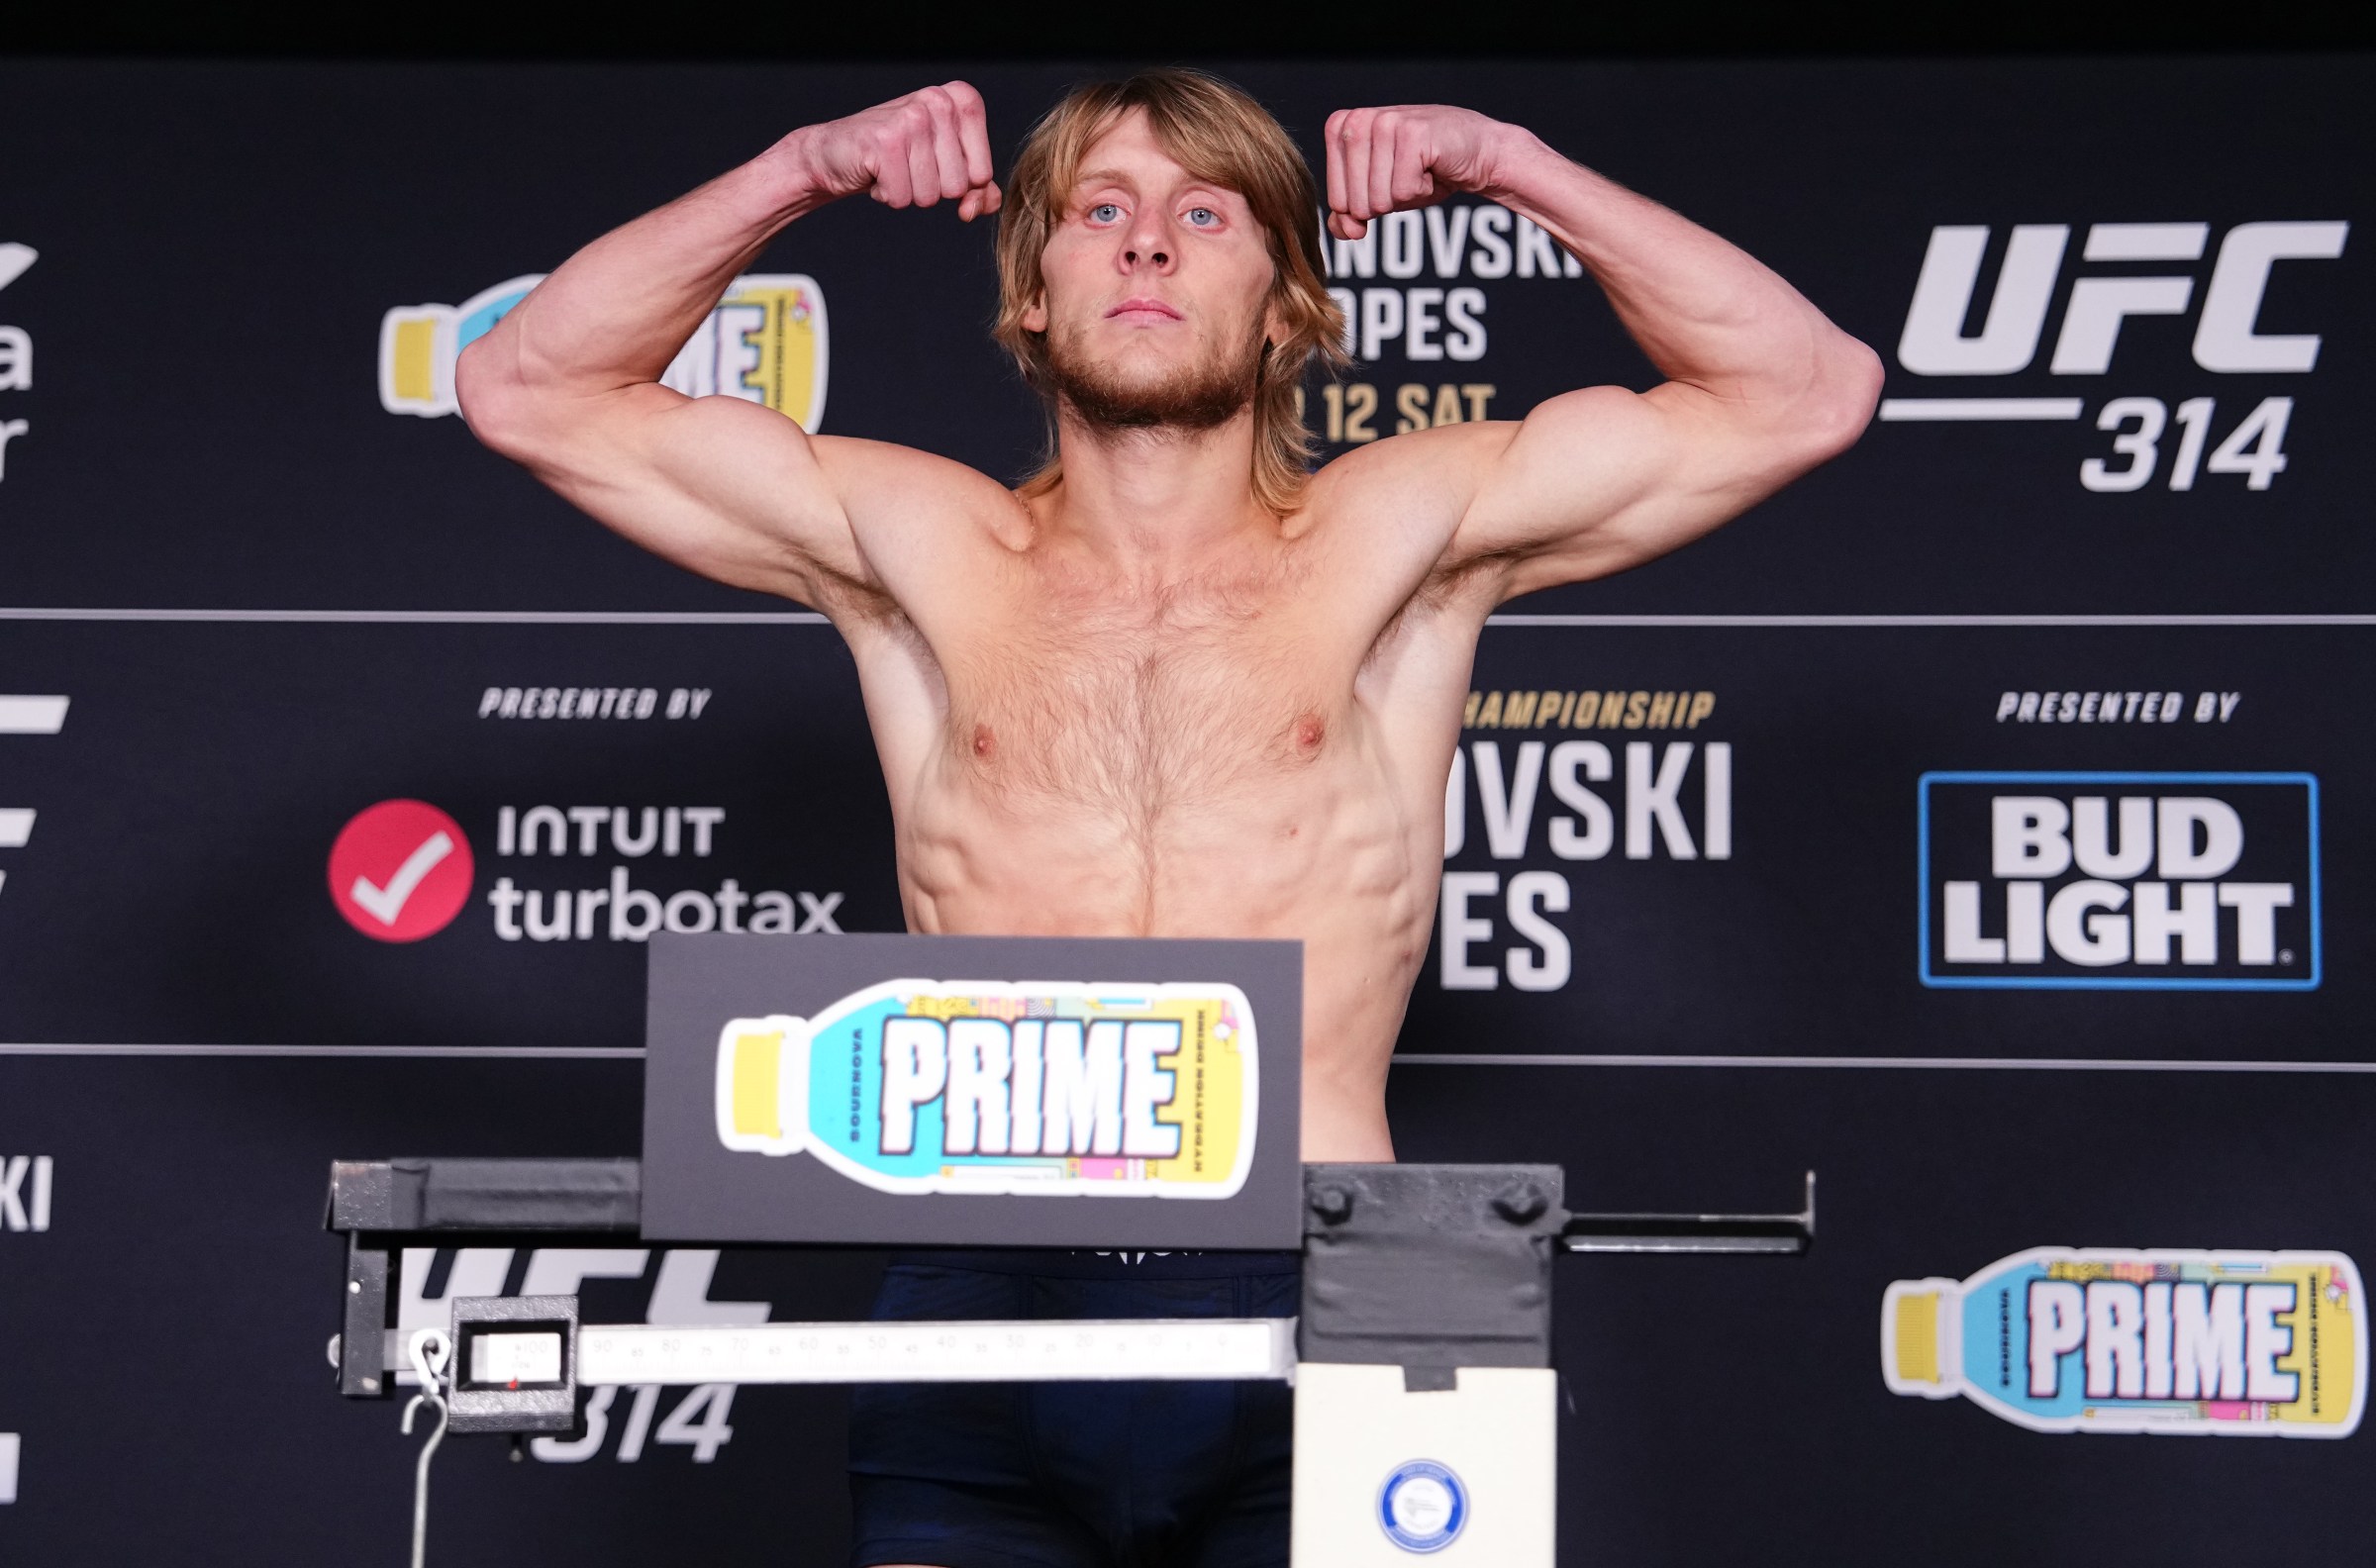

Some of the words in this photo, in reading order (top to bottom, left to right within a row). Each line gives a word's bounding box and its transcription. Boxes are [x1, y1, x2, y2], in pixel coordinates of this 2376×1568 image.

[1318, 205, 1583, 279] NOVSK
[1897, 221, 2351, 376] UFC
[1323, 383, 1379, 442] 12
[1396, 383, 1497, 436] SAT
[2079, 396, 2295, 493] 314
[478, 687, 658, 720] PRESENTED
[665, 688, 712, 720] BY
[1996, 692, 2184, 723] PRESENTED
[2194, 692, 2241, 723] BY
[496, 805, 727, 857] INTUIT
[1991, 796, 2244, 880] BUD
[487, 865, 844, 941] turbotax
[1943, 879, 2295, 966] LIGHT
[879, 1015, 1183, 1158] PRIME
[594, 1339, 612, 1352] 90
[661, 1338, 681, 1352] 80
[732, 1337, 749, 1351] 70
[799, 1337, 819, 1350] 60
[868, 1336, 887, 1349] 50
[937, 1335, 957, 1348] 40
[2026, 1280, 2301, 1403] PRIME
